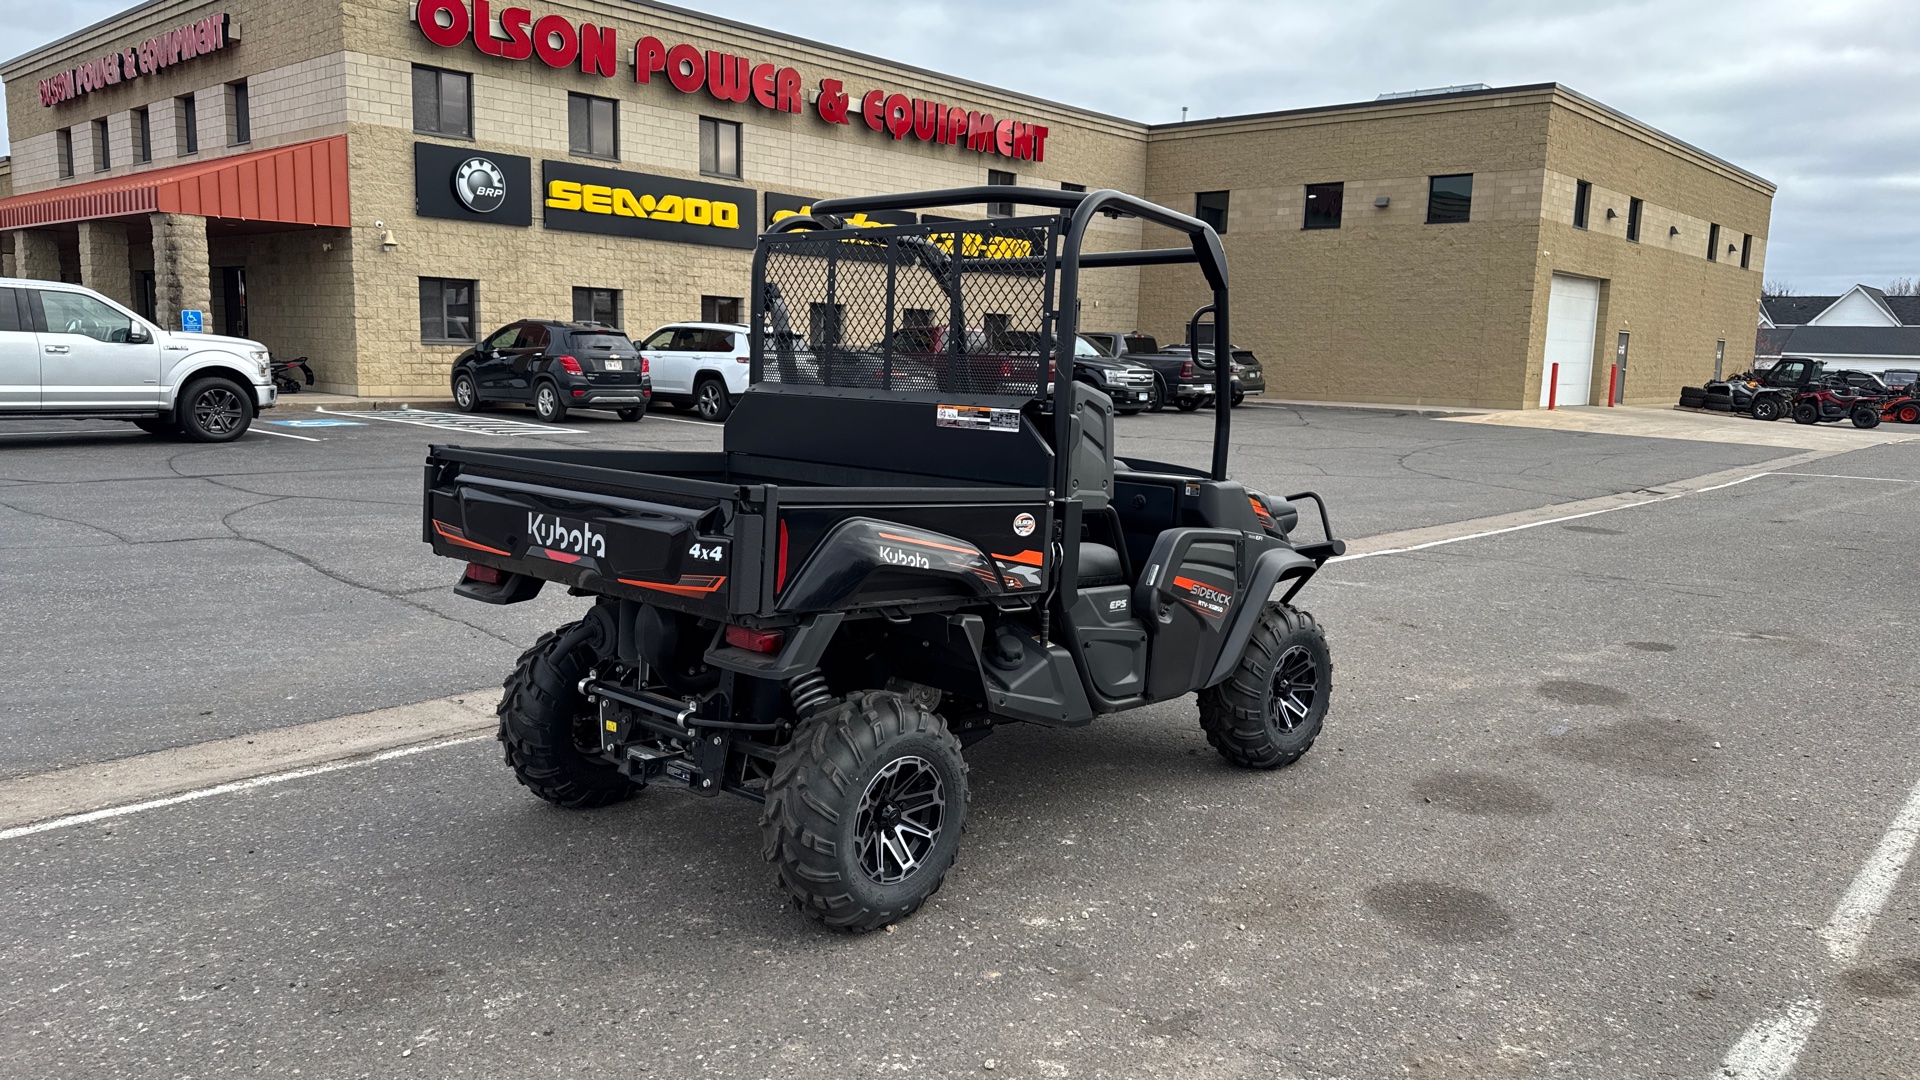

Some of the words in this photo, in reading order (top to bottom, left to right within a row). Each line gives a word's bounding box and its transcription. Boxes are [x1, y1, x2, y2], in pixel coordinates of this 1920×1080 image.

[138, 13, 227, 76] EQUIPMENT
[418, 0, 617, 78] OLSON
[634, 36, 802, 114] POWER
[817, 78, 850, 126] &
[862, 89, 1049, 163] EQUIPMENT
[476, 186, 503, 199] BRP
[527, 511, 606, 559] Kubota
[689, 543, 723, 562] 4x4
[879, 545, 930, 570] Kubota
[1109, 599, 1127, 609] EPS
[1190, 584, 1232, 606] SIDEKICK
